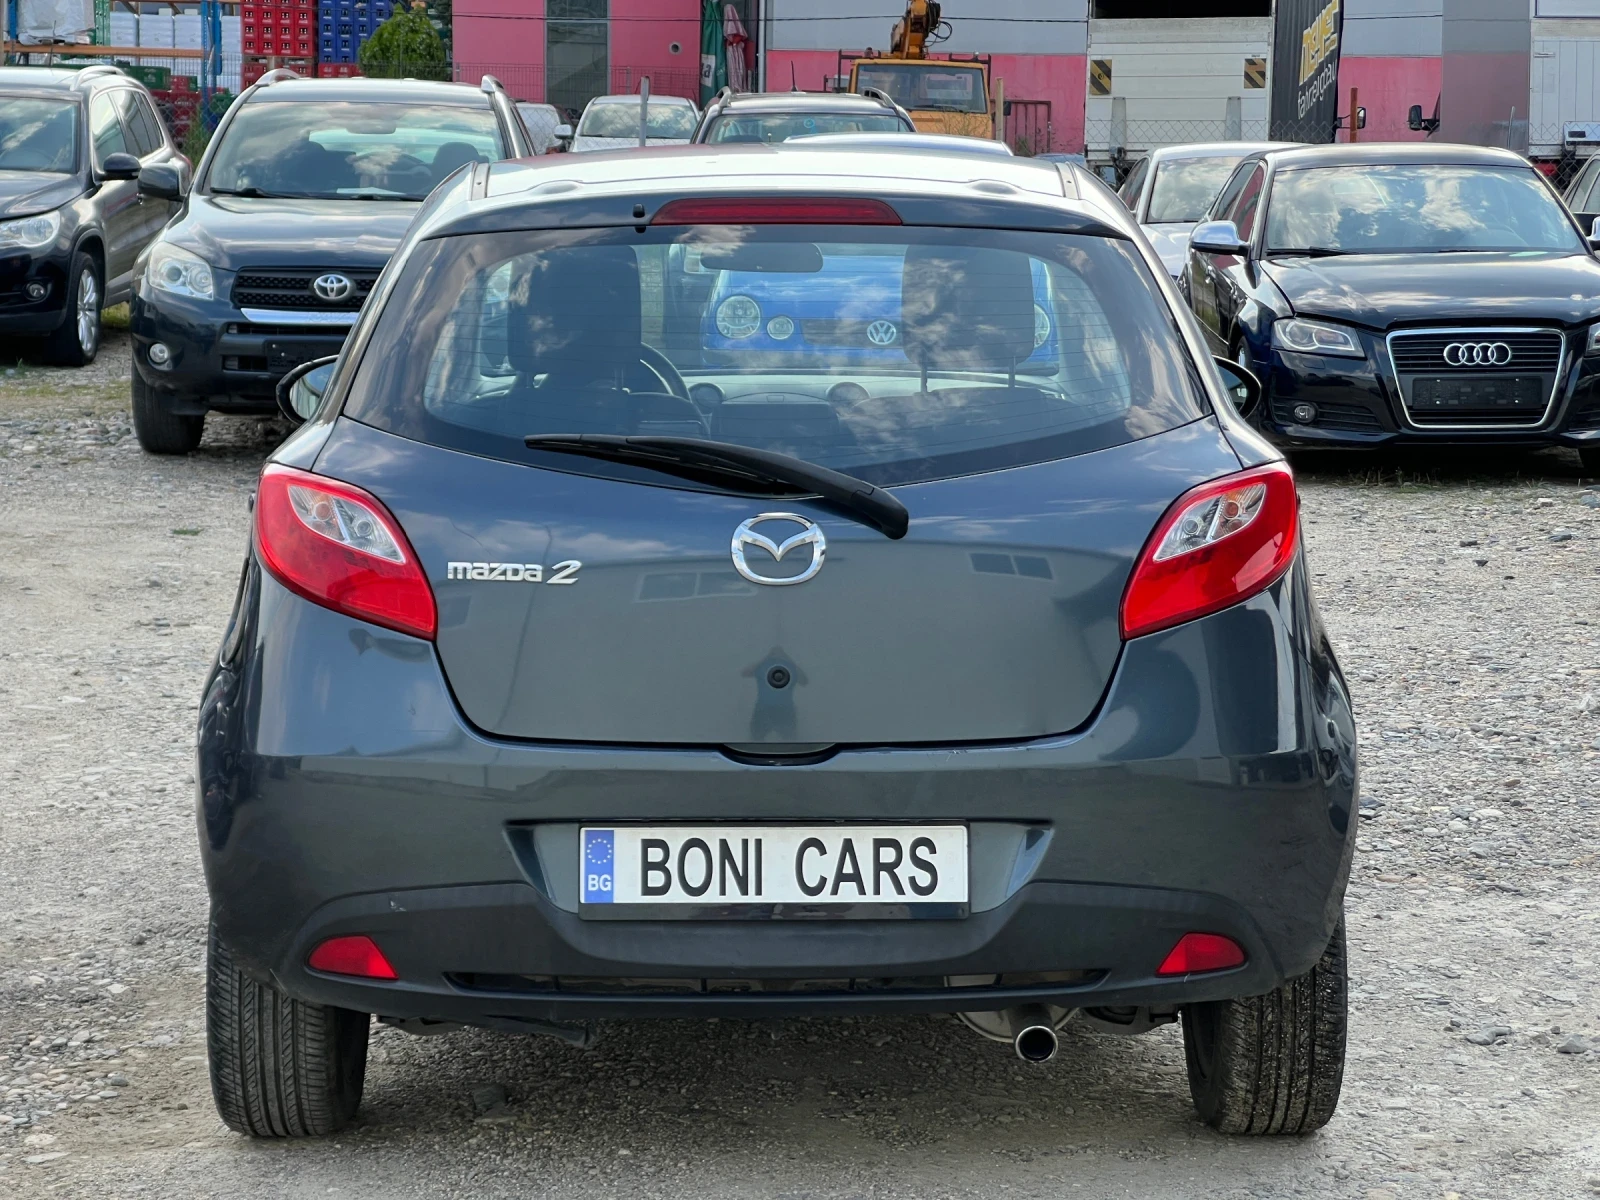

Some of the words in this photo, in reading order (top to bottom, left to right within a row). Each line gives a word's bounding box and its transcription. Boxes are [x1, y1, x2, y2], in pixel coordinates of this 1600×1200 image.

[447, 561, 543, 582] mazda
[546, 560, 582, 584] 2
[640, 837, 763, 897] BONI
[795, 836, 939, 897] CARS
[587, 874, 612, 892] BG
